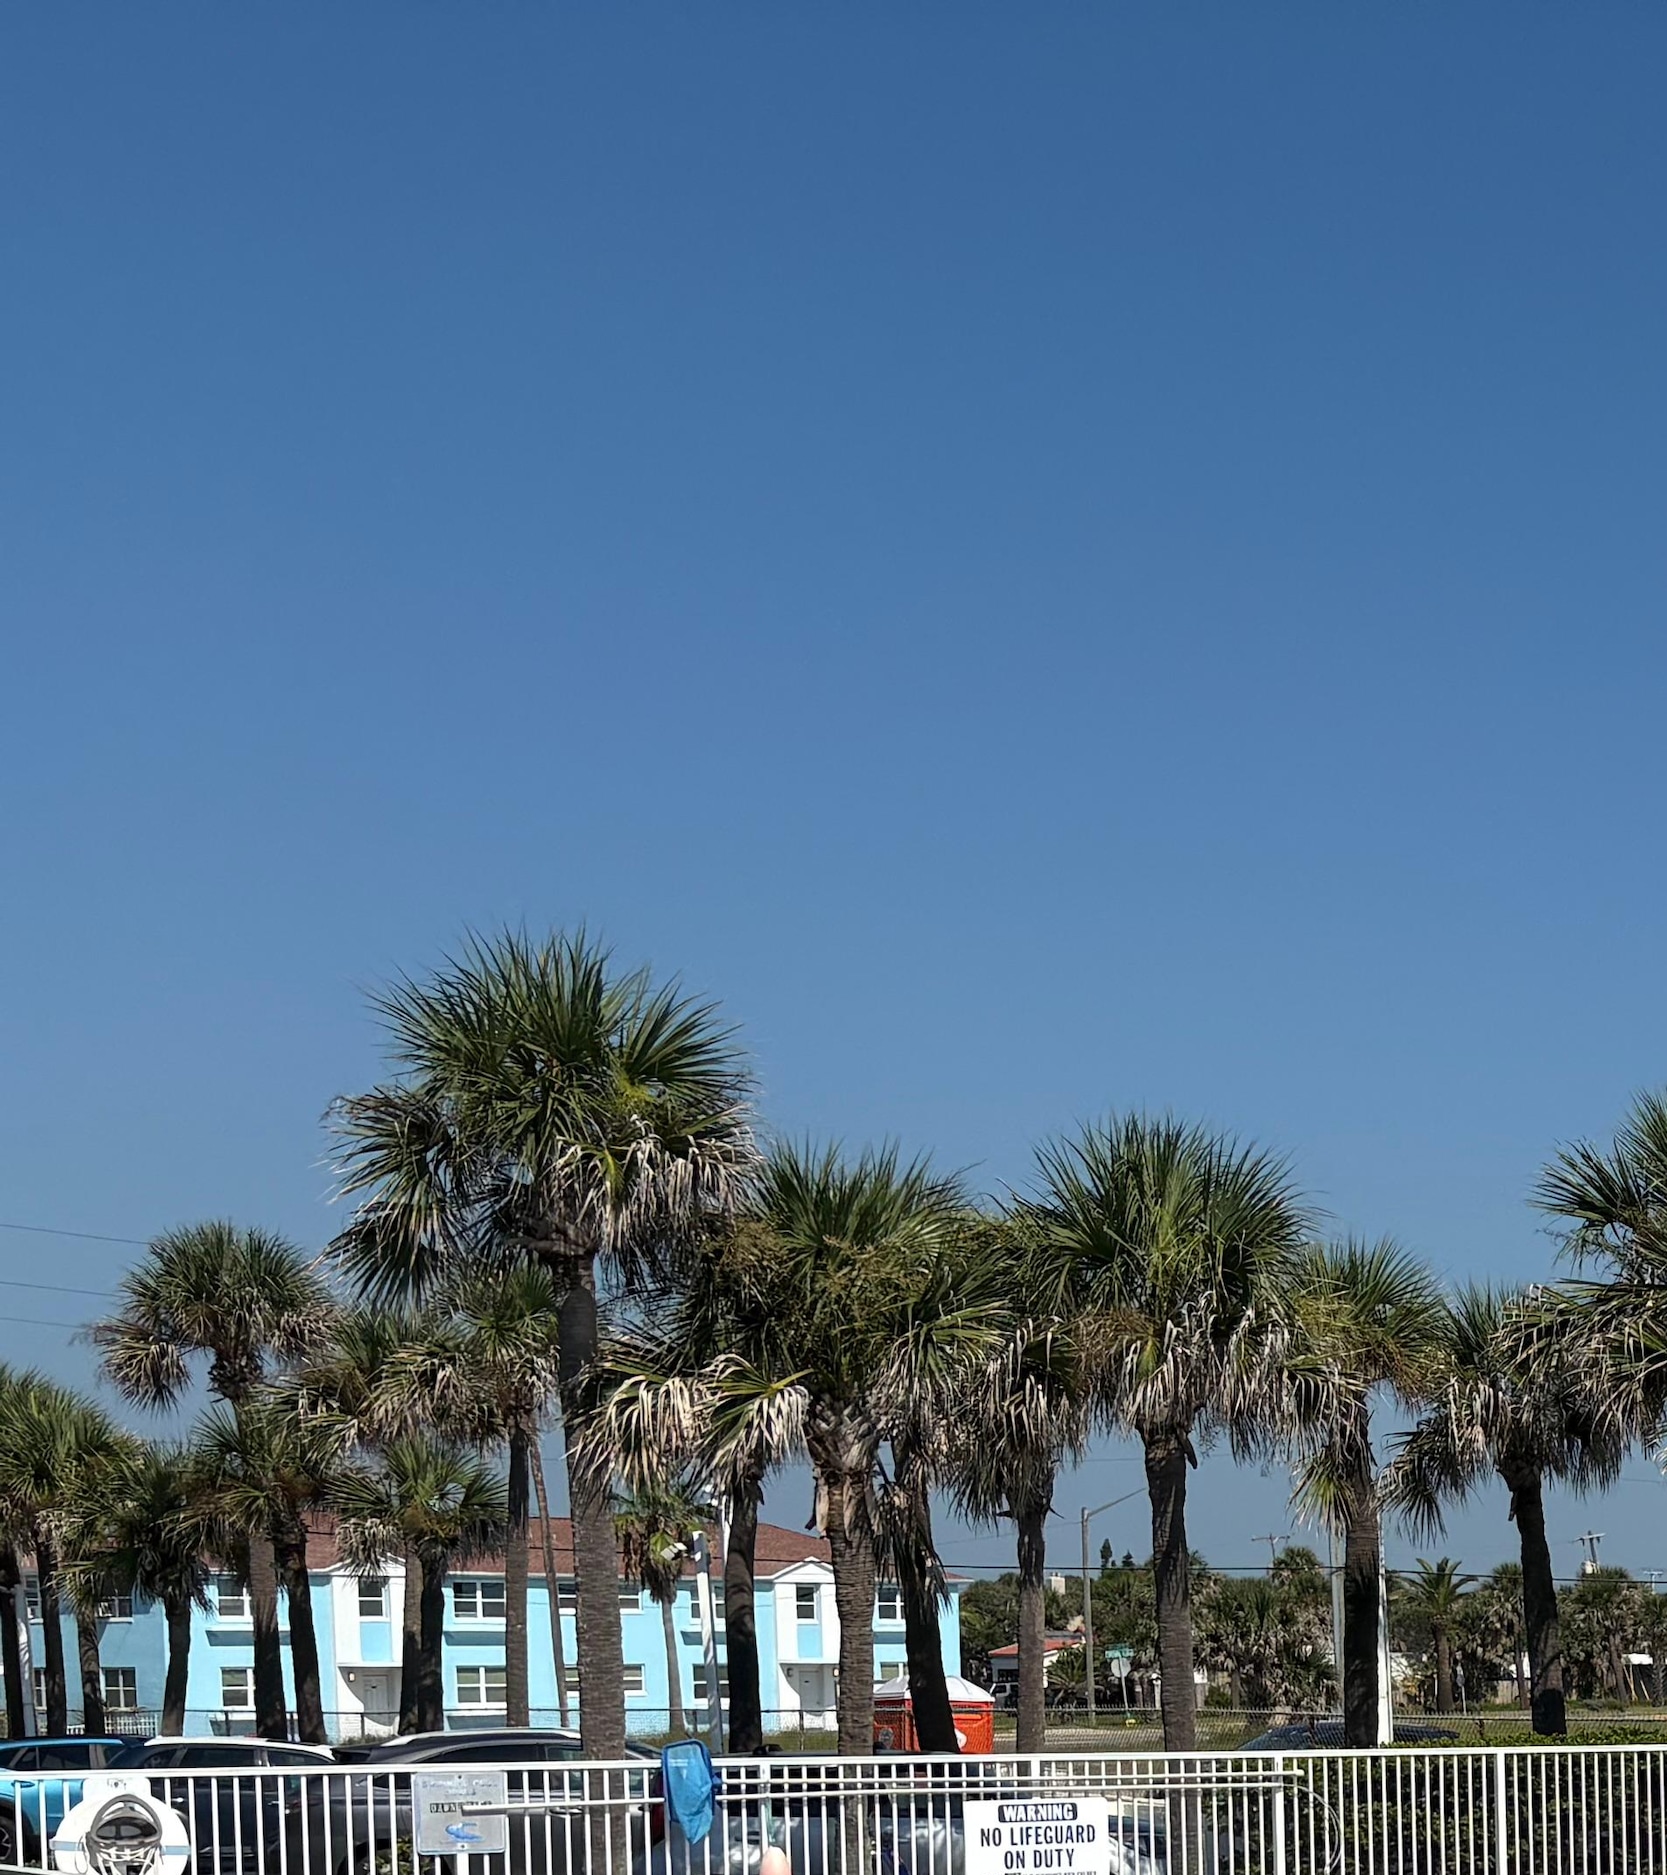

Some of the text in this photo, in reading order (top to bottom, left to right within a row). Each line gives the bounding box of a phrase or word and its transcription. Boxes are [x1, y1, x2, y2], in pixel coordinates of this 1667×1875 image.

[1002, 1803, 1073, 1822] WARNING
[980, 1824, 1096, 1847] NO LIFEGUARD
[1004, 1848, 1075, 1870] ON DUTY
